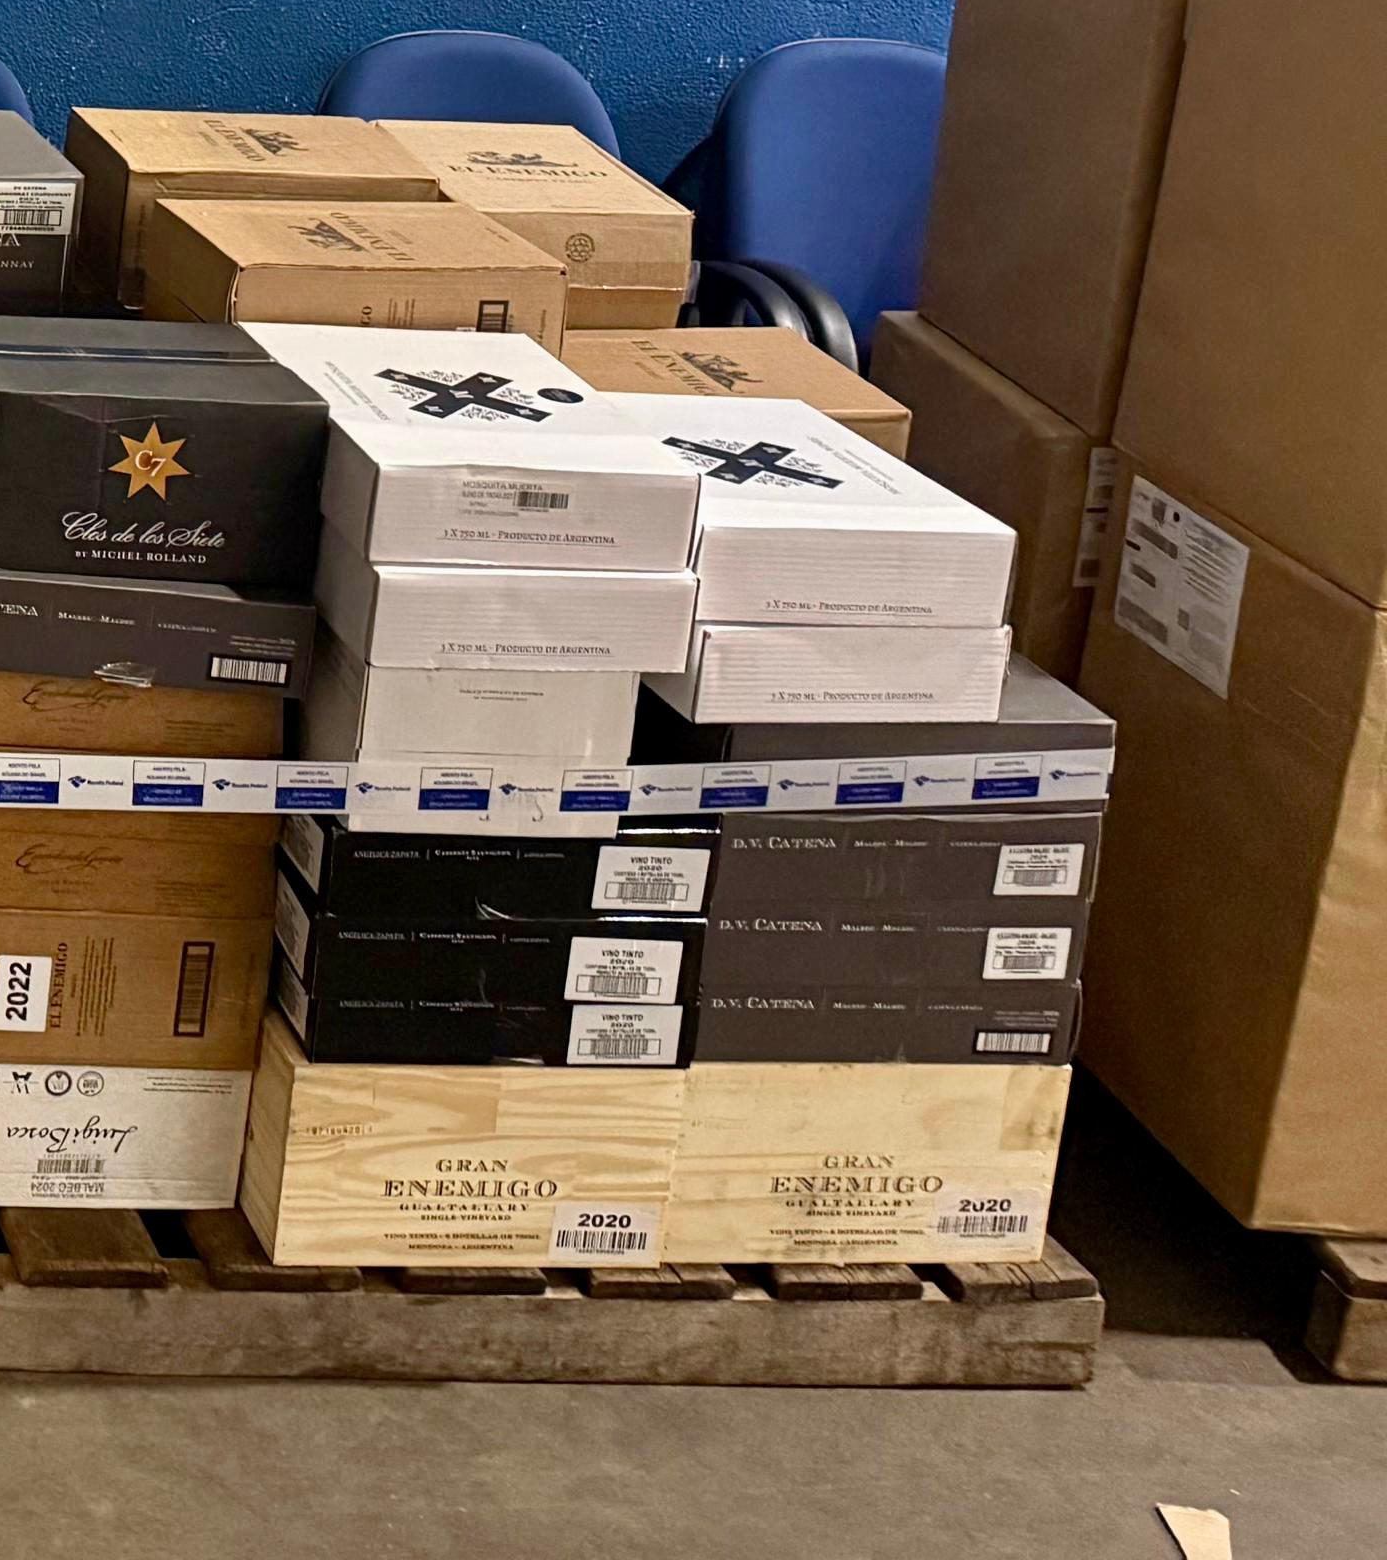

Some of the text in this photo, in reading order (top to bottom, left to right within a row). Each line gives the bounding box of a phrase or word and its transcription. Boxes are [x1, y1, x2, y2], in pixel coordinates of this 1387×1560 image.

[488, 167, 608, 178] ENEMIGO
[134, 449, 166, 479] C7
[61, 511, 226, 549] Clos de los Siete
[498, 530, 547, 541] PRODUCTO
[548, 532, 561, 541] DE
[562, 533, 615, 545] ARGENTINA
[75, 549, 207, 564] BY MICHEL ROLLAND
[732, 837, 836, 849] D.V. CATENA
[631, 856, 672, 865] VINO TINTO
[719, 918, 823, 931] D.V. CATENA
[602, 950, 644, 958] VINO TINTO
[51, 942, 68, 1011] ENEMIGO
[5, 962, 32, 1021] 2022
[711, 997, 815, 1009] D.V. CATENA
[602, 1014, 643, 1022] VINO TINTO
[6, 1116, 139, 1153] Luigi Bosca
[436, 1159, 509, 1172] GRAN
[822, 1155, 895, 1169] GRAN
[59, 1181, 104, 1192] MALBEC
[380, 1179, 558, 1198] ENEMIGO
[770, 1175, 944, 1194] ENEMIGO
[399, 1203, 530, 1212] GUALTALLARY
[785, 1199, 915, 1208] GUALTALLARY
[959, 1199, 1012, 1213] 2020
[578, 1213, 632, 1228] 2020
